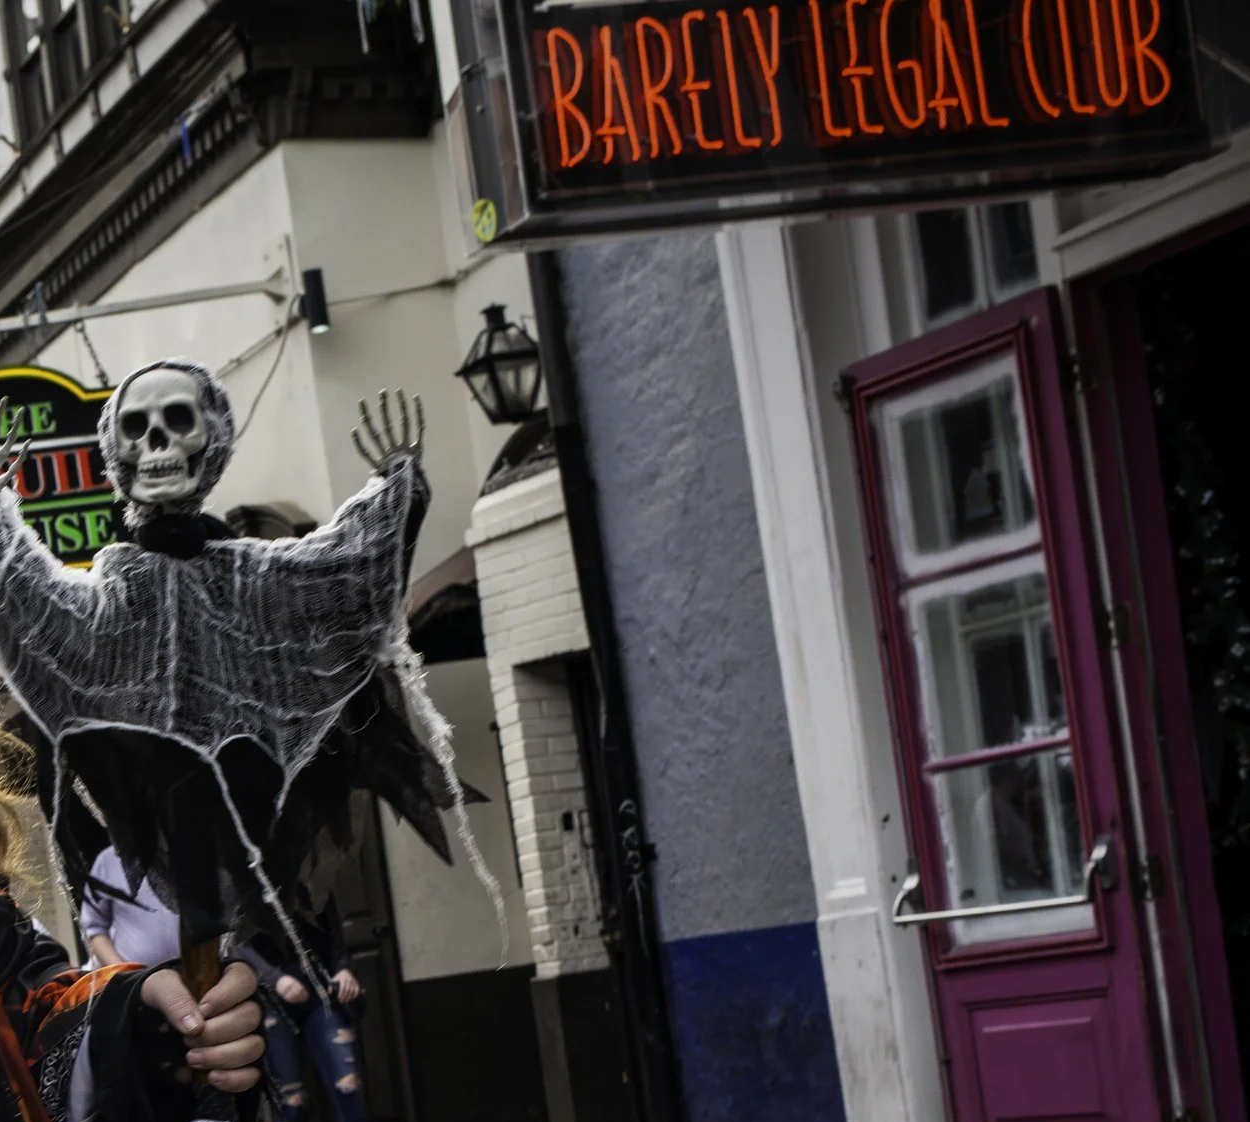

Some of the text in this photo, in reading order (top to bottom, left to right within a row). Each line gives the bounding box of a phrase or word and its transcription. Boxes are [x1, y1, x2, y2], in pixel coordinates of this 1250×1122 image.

[547, 0, 1172, 167] BARELY LEGAL CLUB
